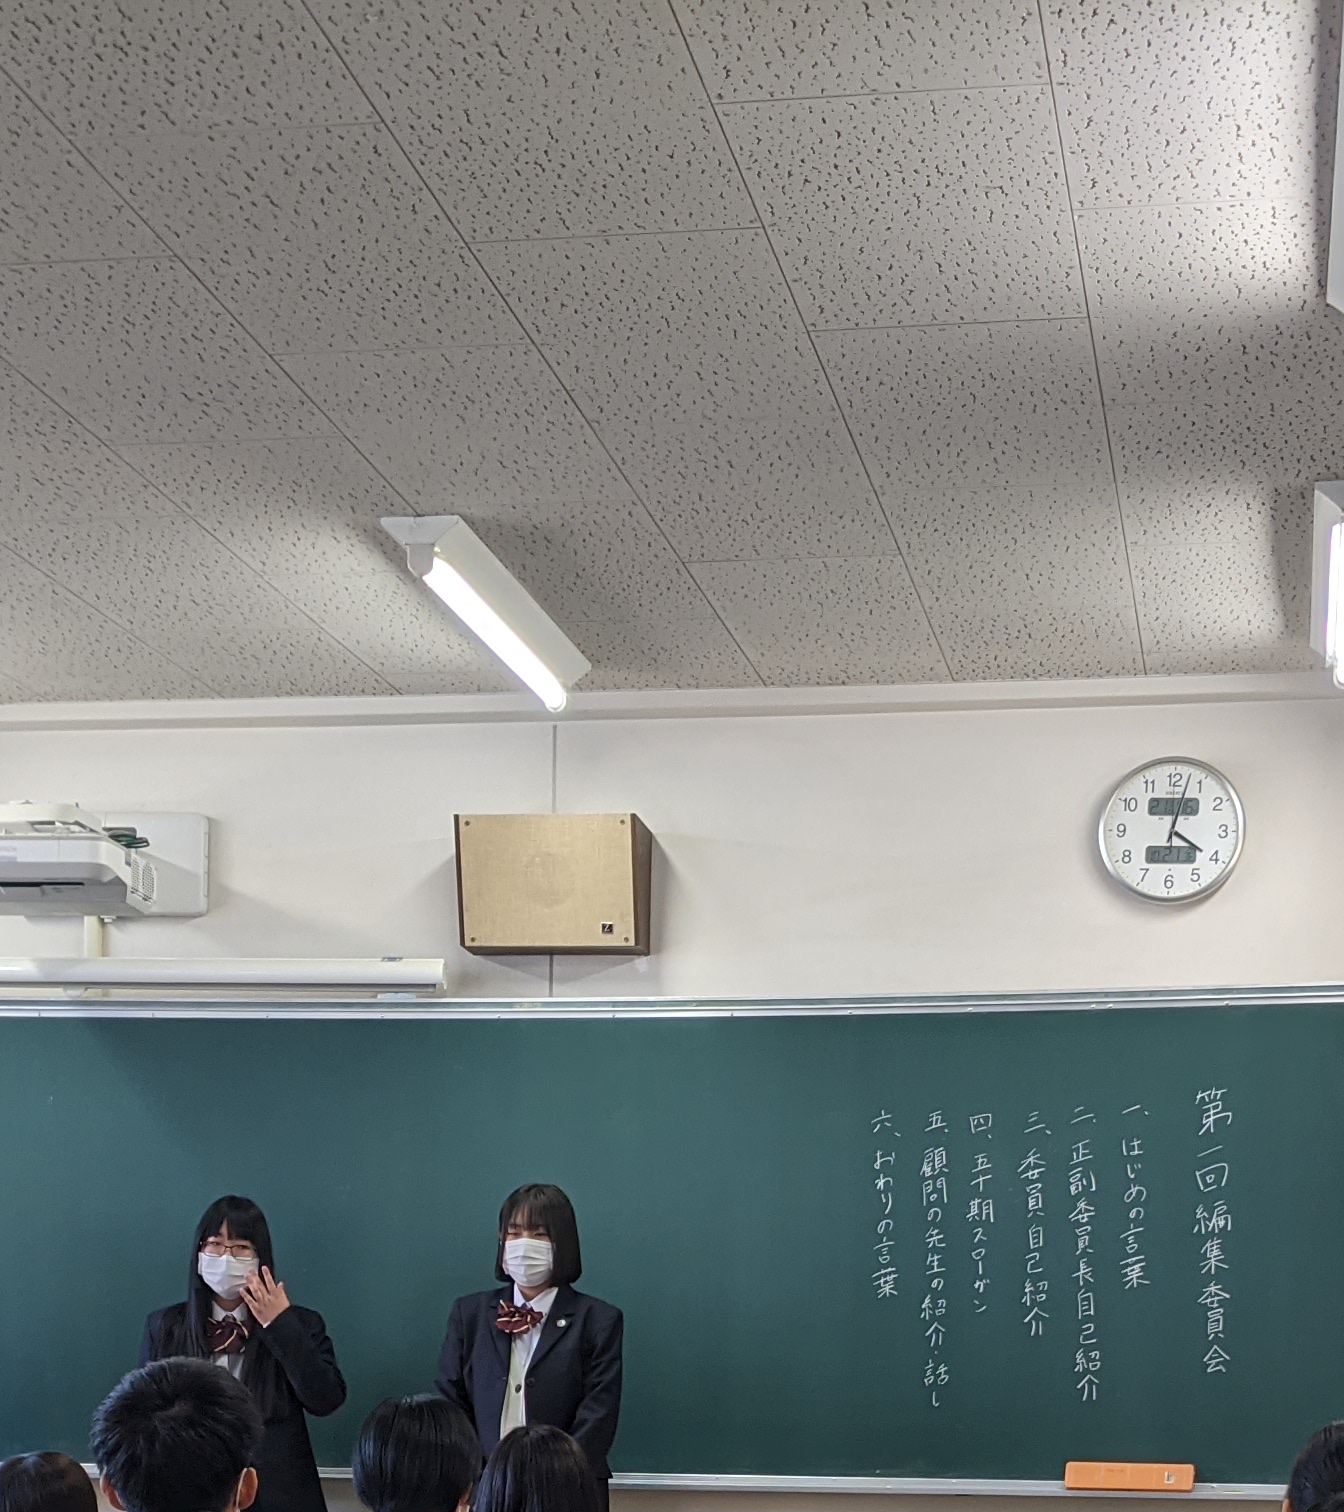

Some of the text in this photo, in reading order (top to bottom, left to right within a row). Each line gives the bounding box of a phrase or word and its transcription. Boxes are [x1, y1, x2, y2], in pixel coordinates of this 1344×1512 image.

[1143, 779, 1155, 794] 11
[1167, 773, 1183, 787] 12
[1197, 780, 1202, 794] 1
[1123, 798, 1138, 812] 10
[1212, 797, 1222, 812] 2
[1116, 823, 1126, 838] 9
[1218, 824, 1228, 838] 3
[1121, 850, 1132, 864] 8
[1209, 850, 1220, 864] 4
[1139, 868, 1150, 882] 7
[1164, 874, 1174, 888] 6
[1190, 868, 1200, 882] 5
[870, 1108, 901, 1299] 六、おわりの言葉
[1120, 1106, 1151, 1289] 一、はじめの言葉
[965, 1112, 996, 1314] 四、五十期スローガン
[1018, 1111, 1052, 1336] 三、委員自己紹介
[1193, 1087, 1232, 1374] 第一回編集委員会
[1068, 1106, 1102, 1402] 二、正副委員長自己紹介
